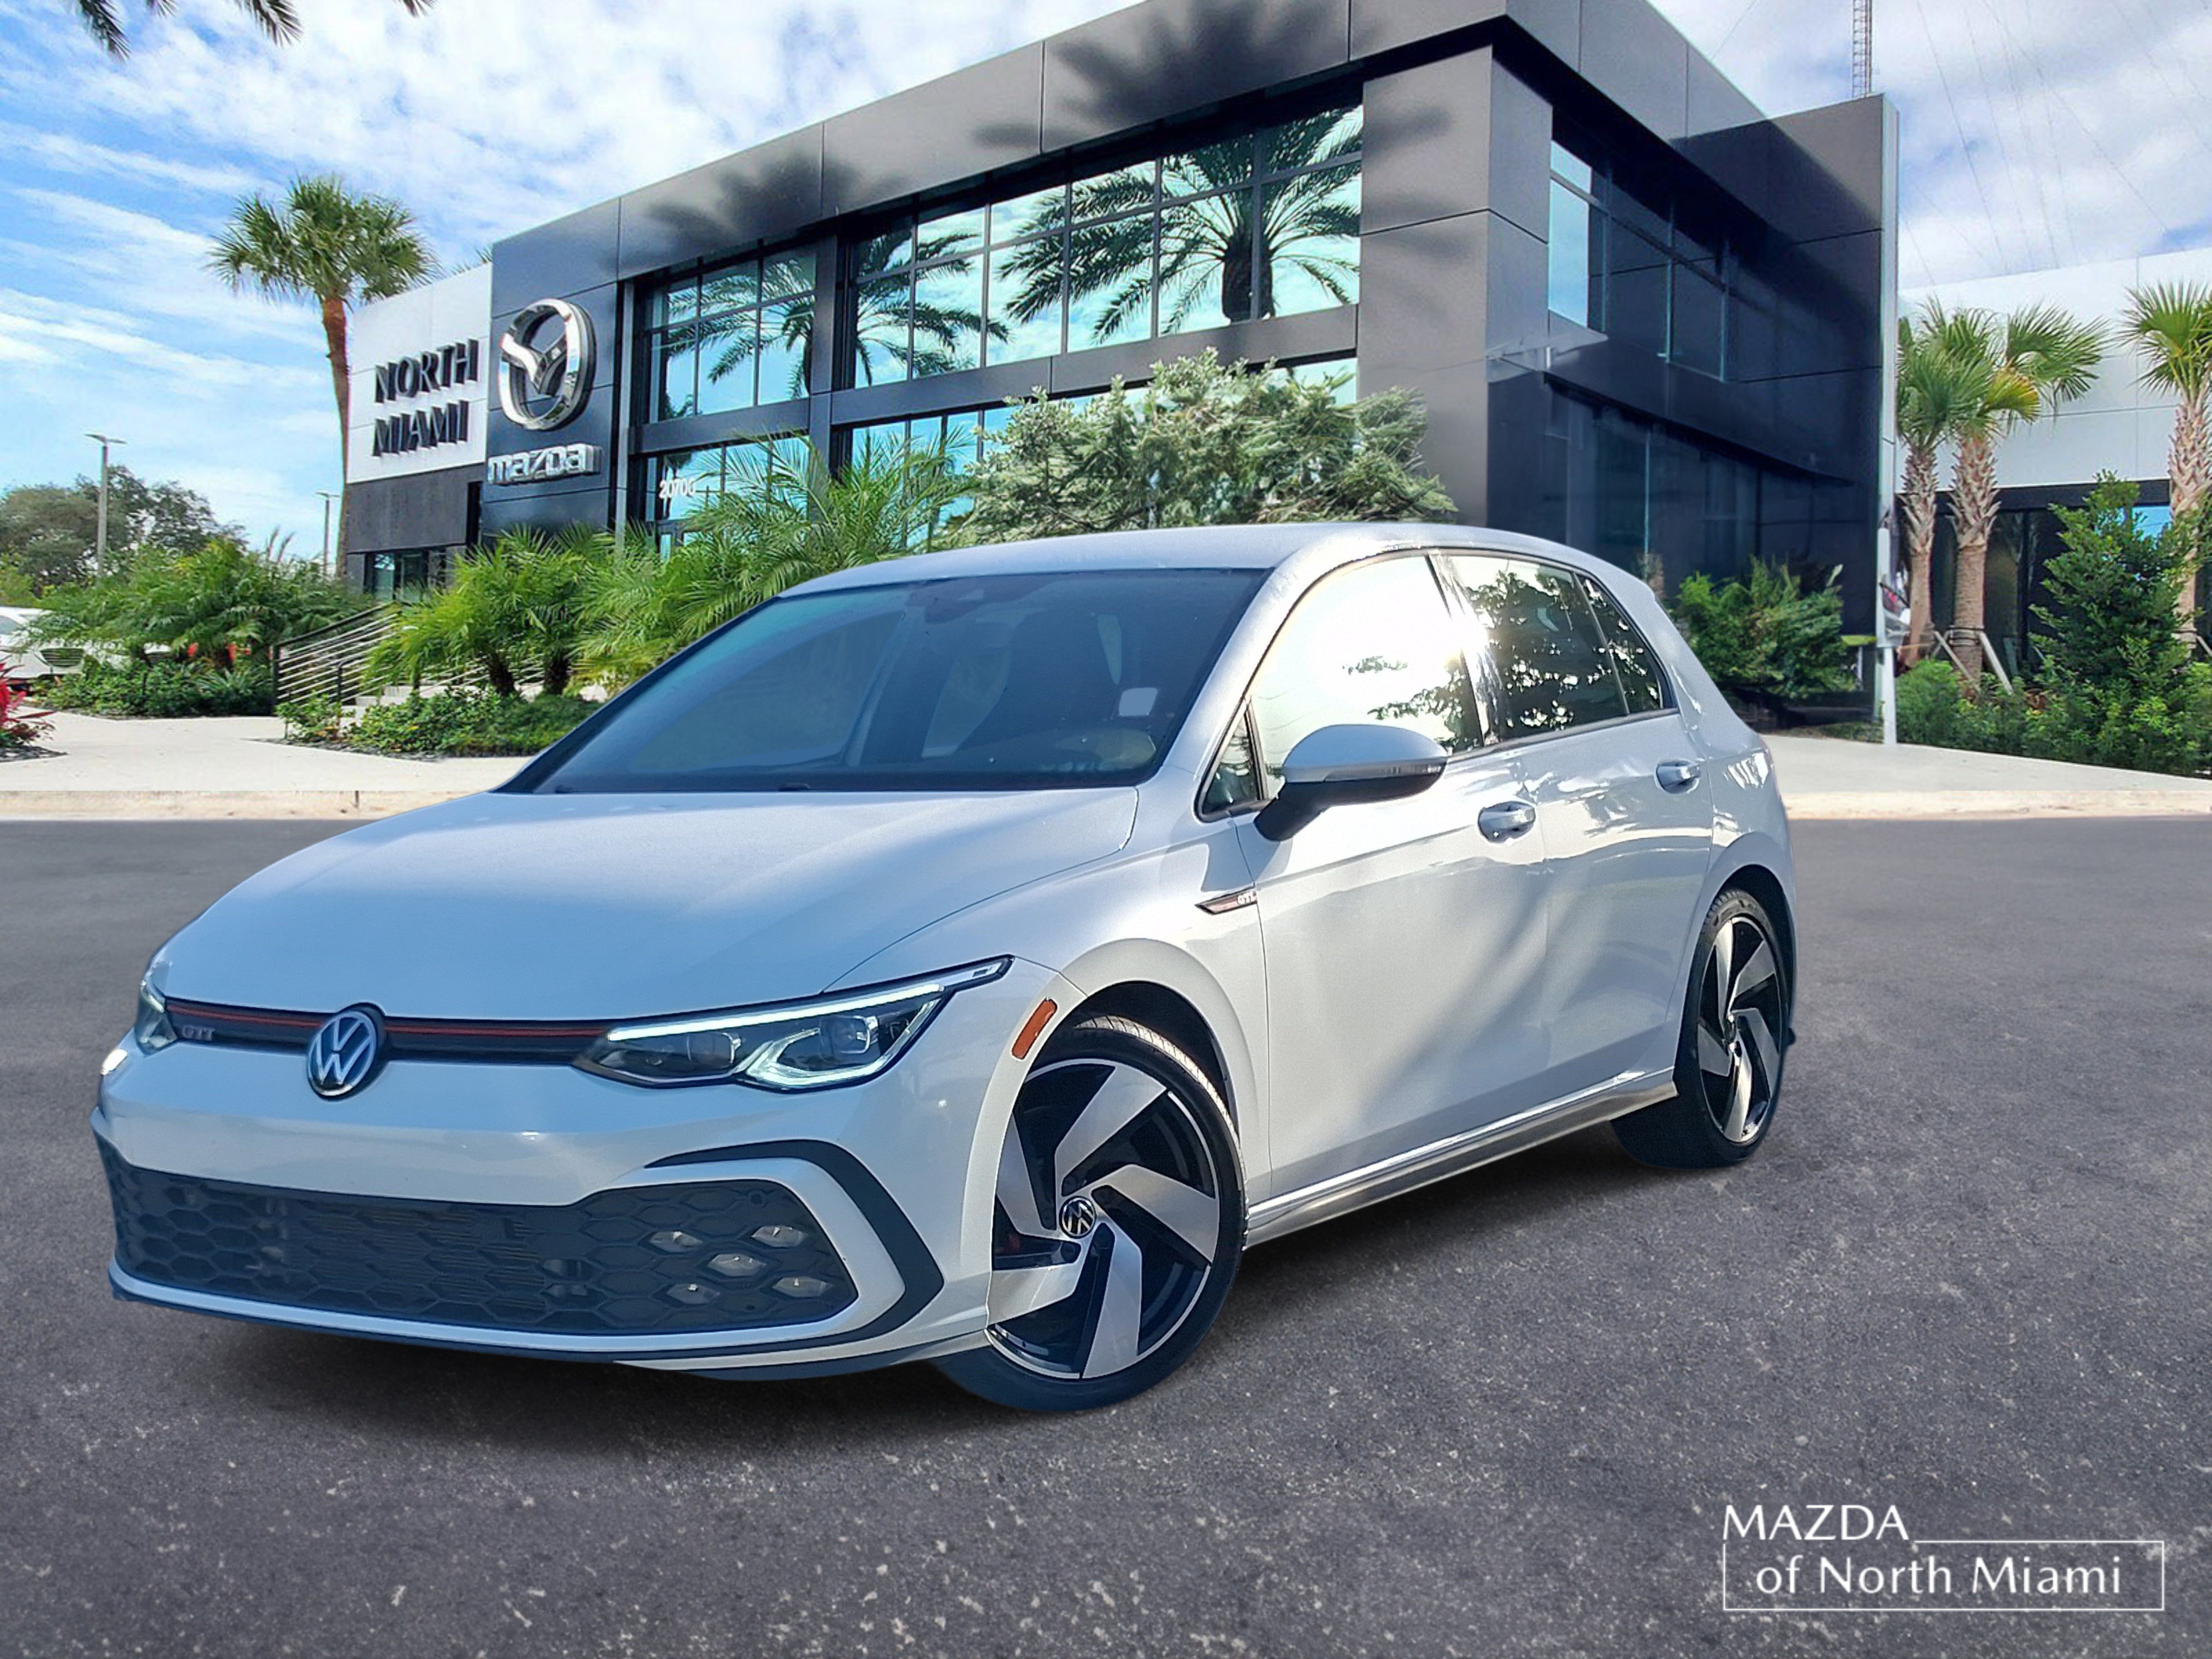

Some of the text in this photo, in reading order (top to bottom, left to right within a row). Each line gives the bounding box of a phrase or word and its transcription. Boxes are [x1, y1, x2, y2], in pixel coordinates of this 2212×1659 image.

[374, 339, 478, 404] NORTH
[372, 400, 469, 457] MIAMI
[488, 443, 593, 484] mazda
